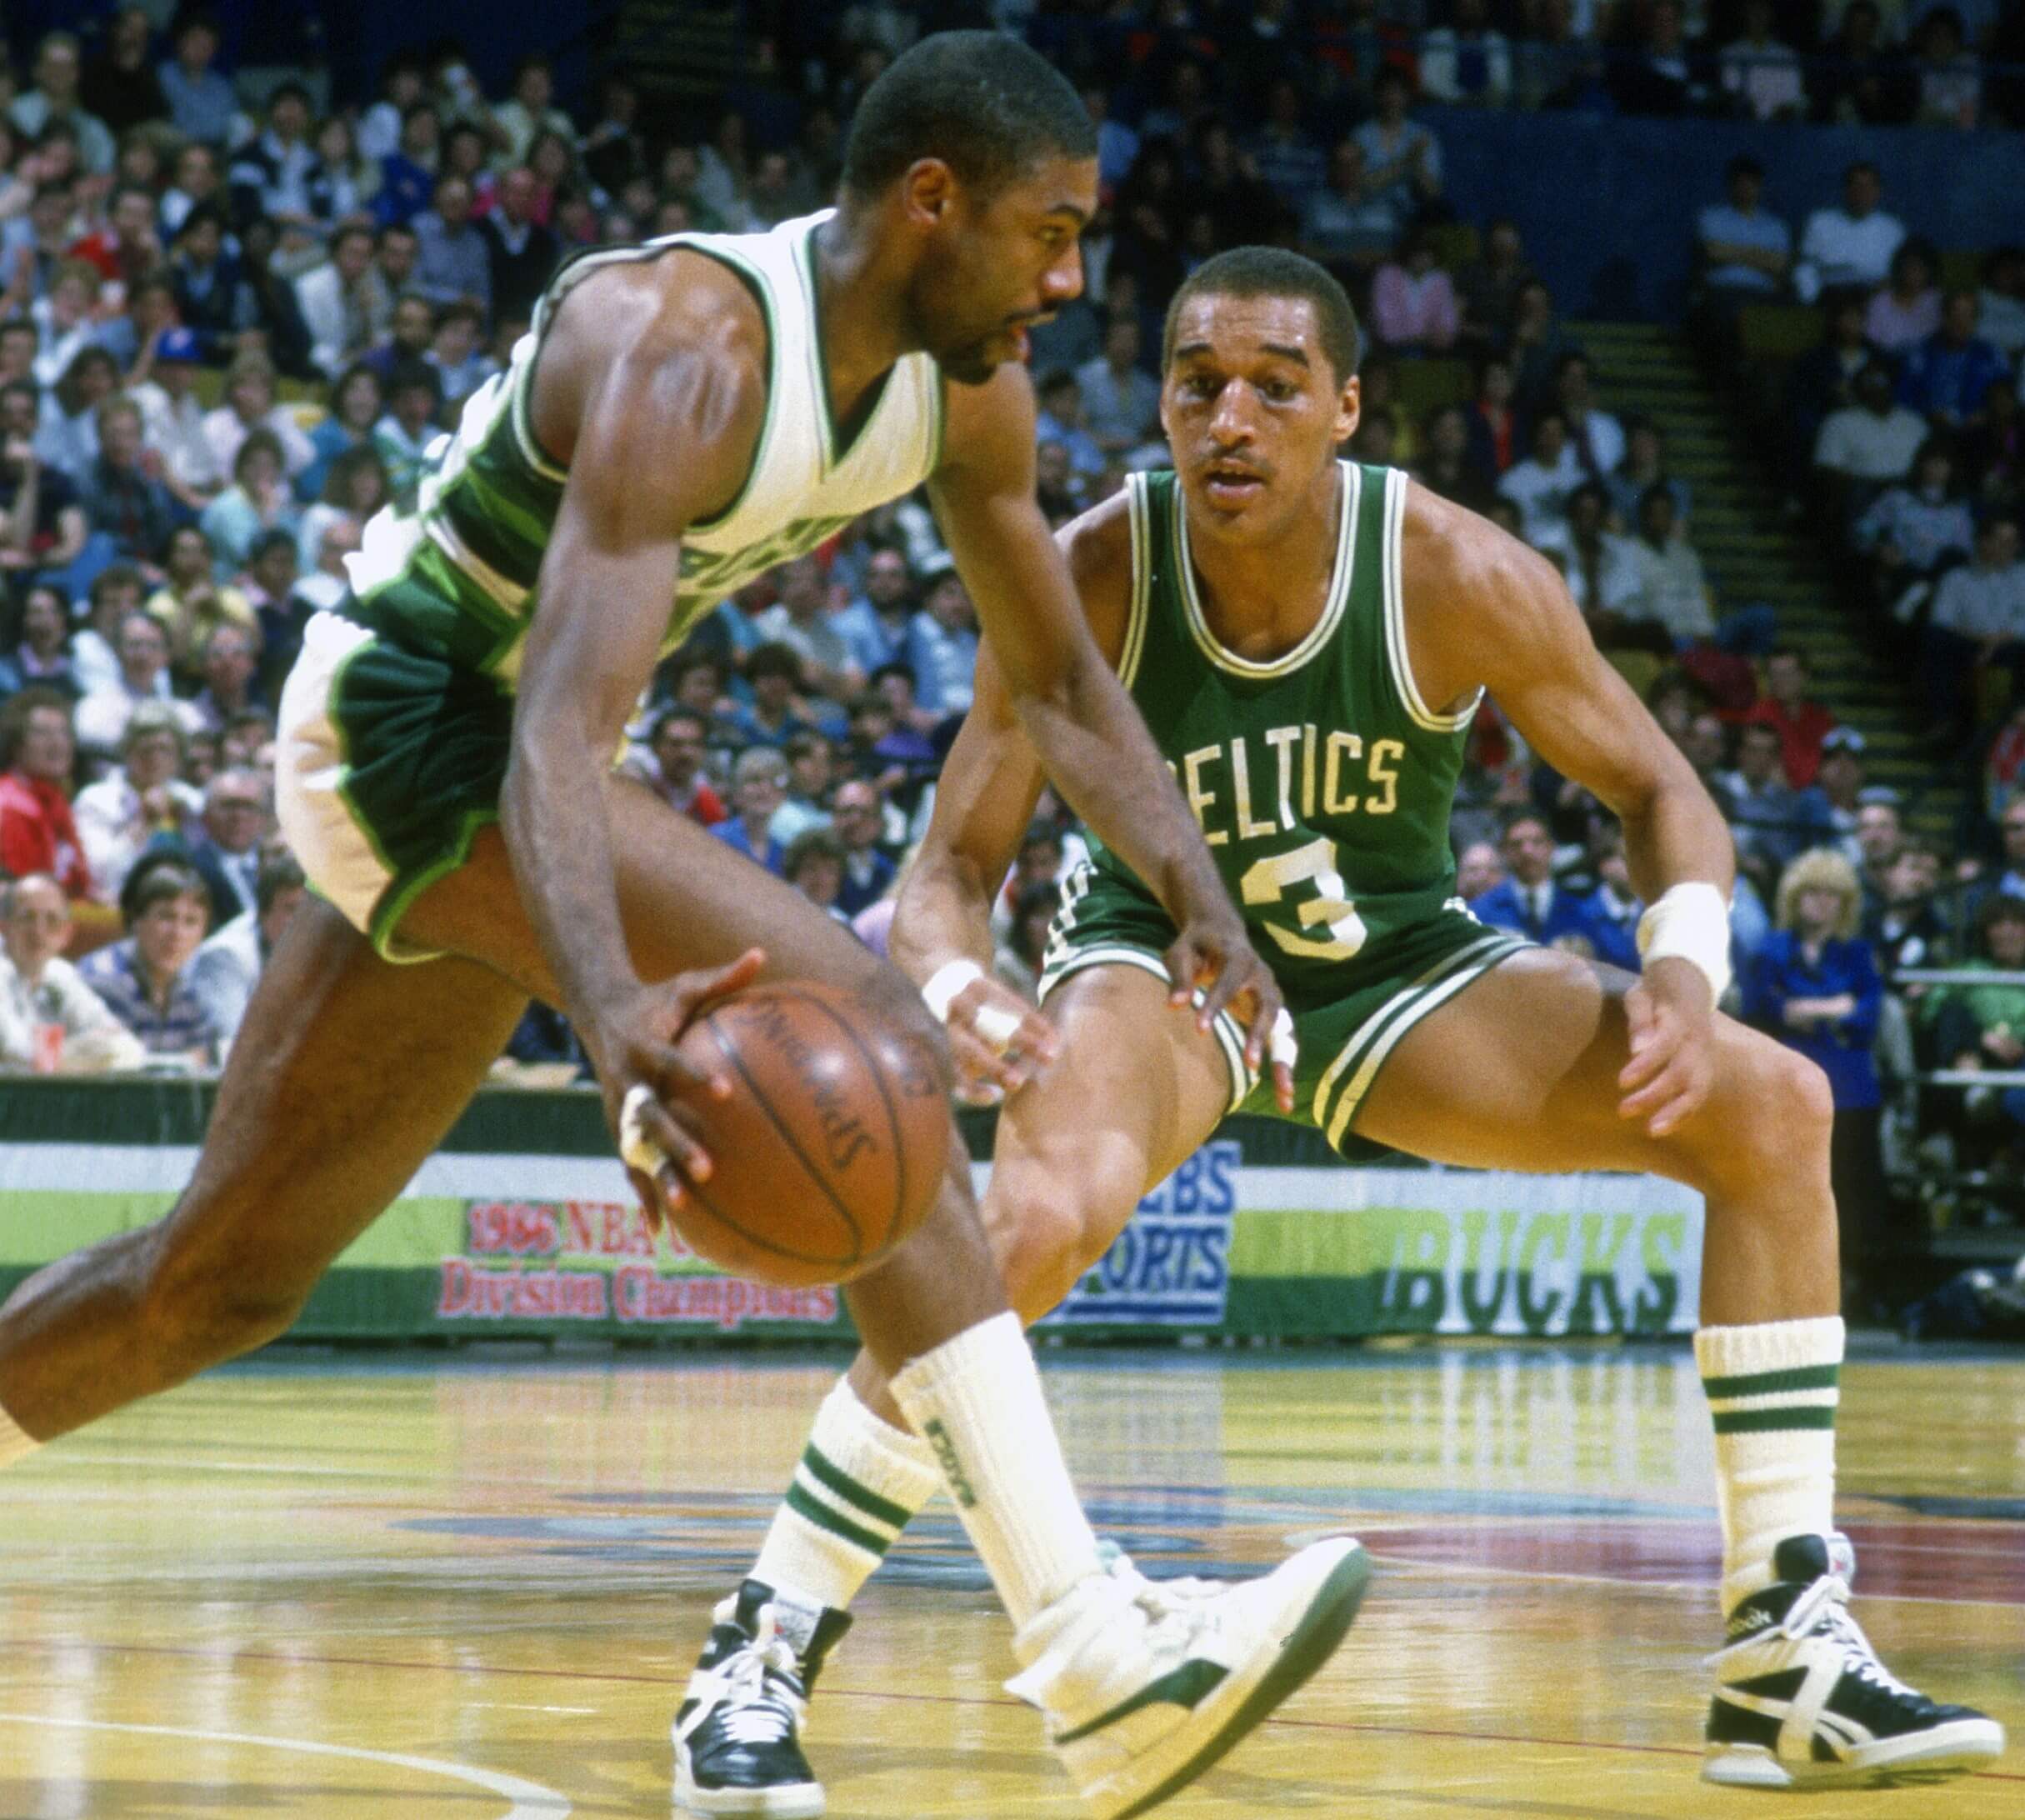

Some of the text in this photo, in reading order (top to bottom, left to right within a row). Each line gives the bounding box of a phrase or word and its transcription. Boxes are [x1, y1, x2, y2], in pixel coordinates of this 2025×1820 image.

[1166, 722, 1405, 846] ELTICS
[1240, 837, 1368, 960] 3
[1136, 1147, 1237, 1214] BS
[562, 1198, 657, 1255] NBA
[1083, 1225, 1228, 1291] ORTS
[441, 1259, 606, 1317] Division
[1383, 1208, 1687, 1334] BUCKS
